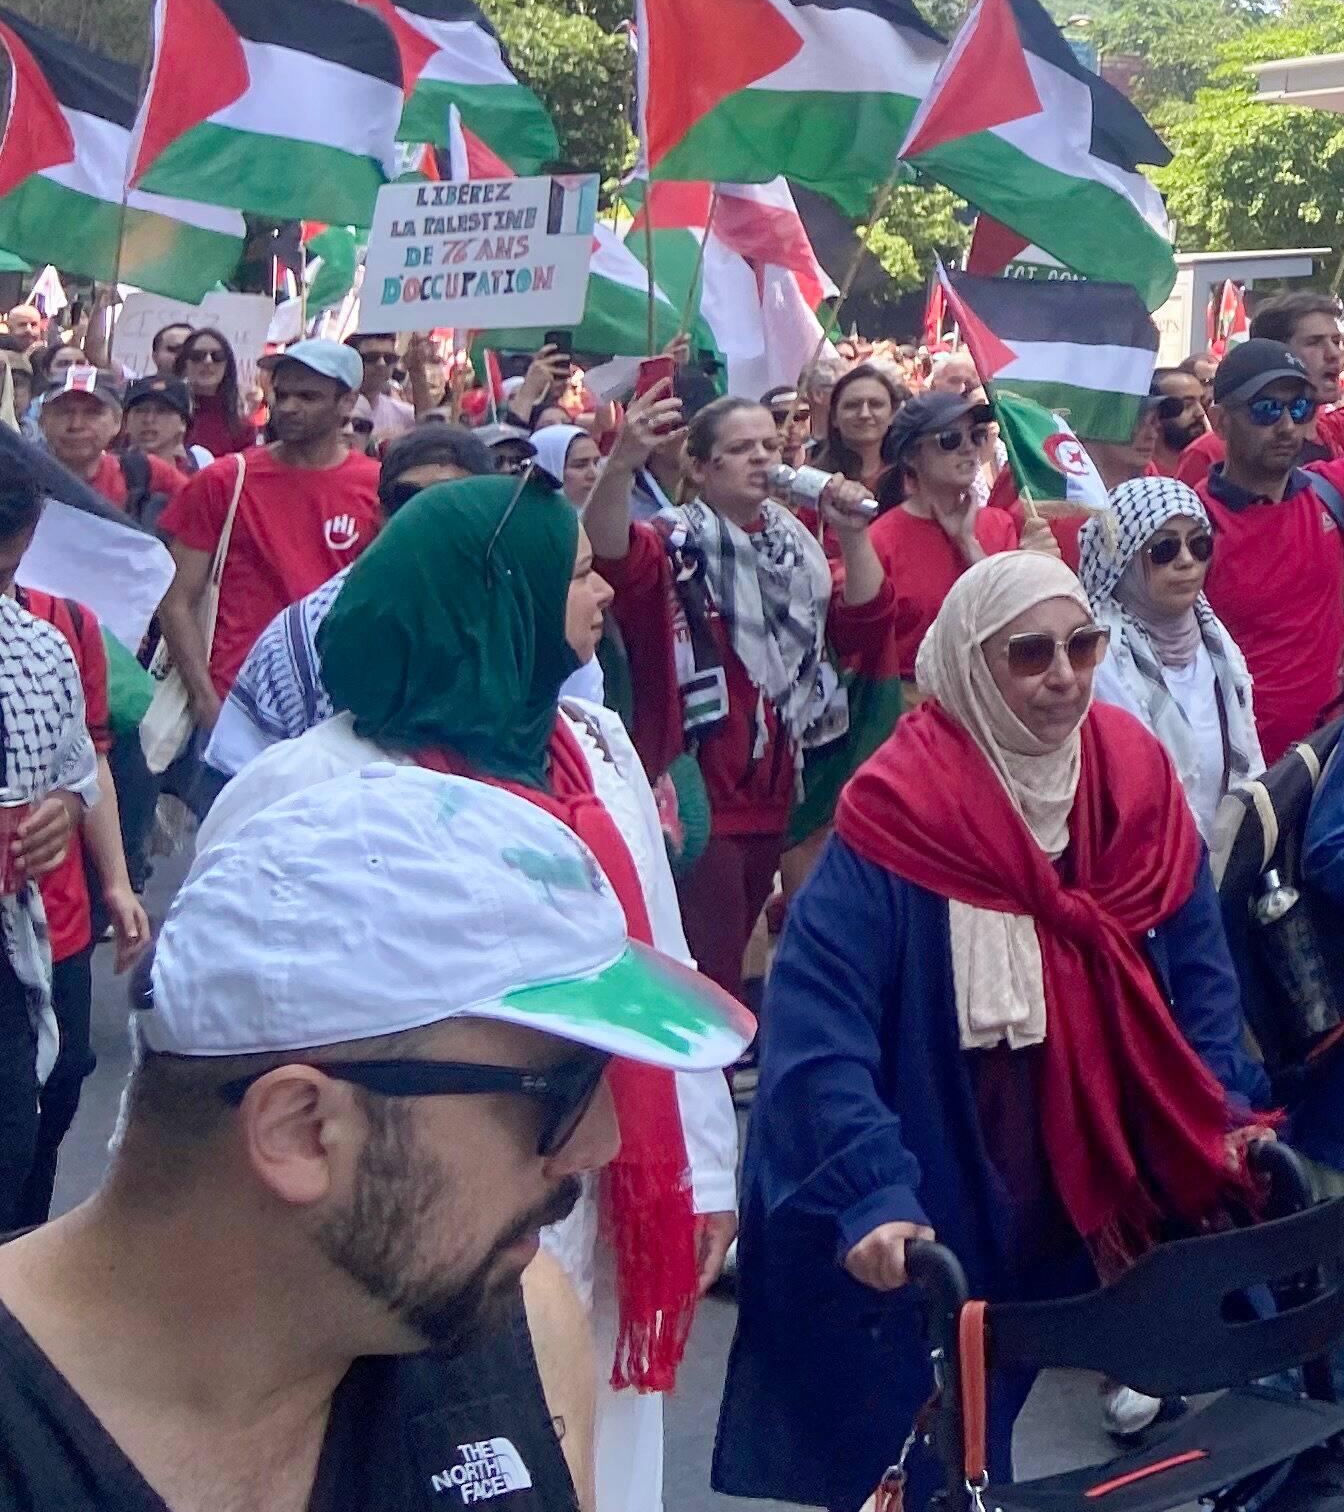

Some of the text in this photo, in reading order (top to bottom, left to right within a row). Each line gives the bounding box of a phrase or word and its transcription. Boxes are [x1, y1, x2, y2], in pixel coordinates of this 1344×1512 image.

[391, 207, 538, 238] LA PALESTINE
[404, 245, 434, 268] DE
[474, 235, 530, 261] ANS
[381, 265, 556, 305] D'OCCUPATION
[457, 1441, 496, 1462] THE
[431, 1457, 501, 1492] NORTH
[460, 1475, 508, 1505] FACE
